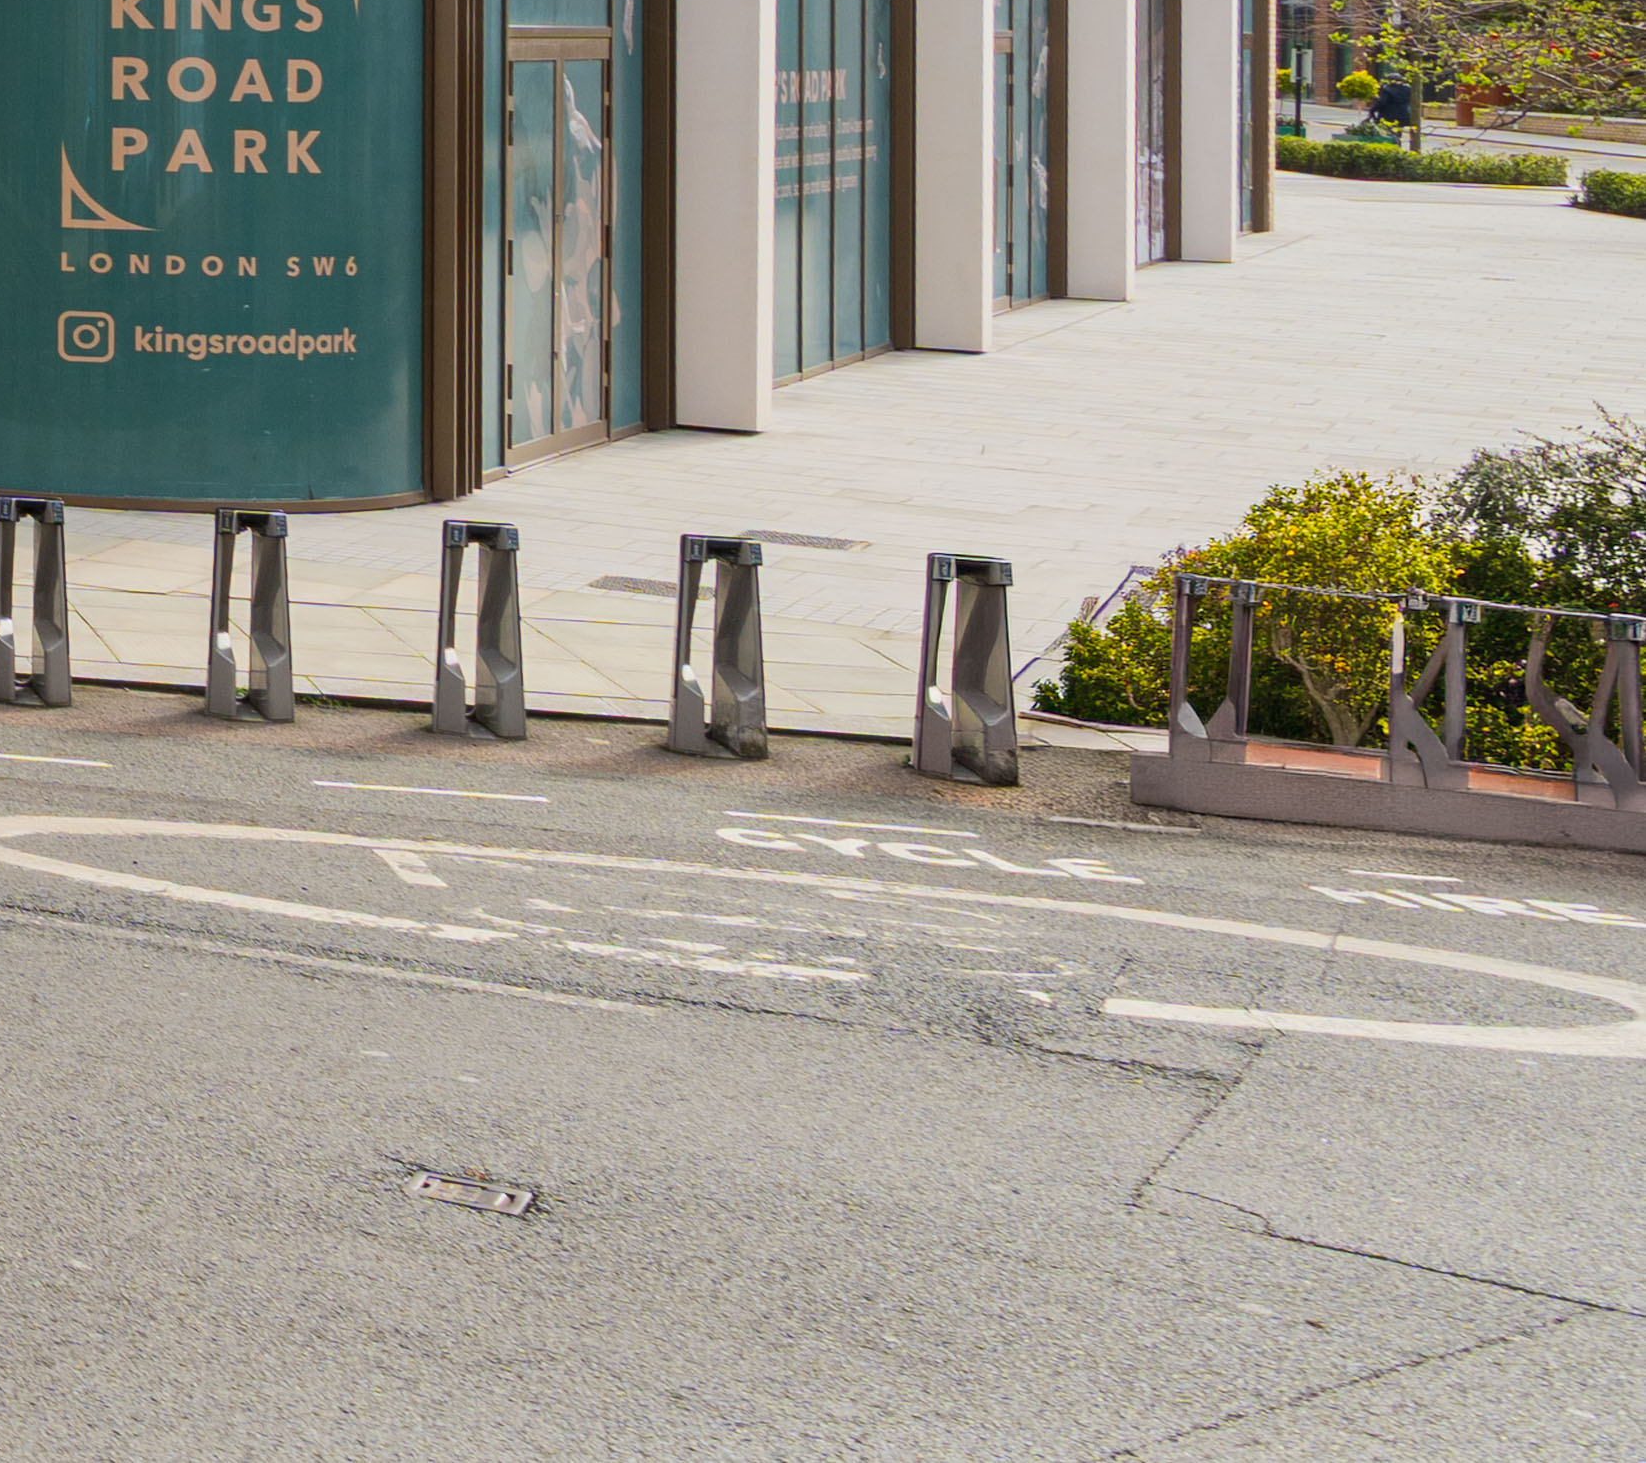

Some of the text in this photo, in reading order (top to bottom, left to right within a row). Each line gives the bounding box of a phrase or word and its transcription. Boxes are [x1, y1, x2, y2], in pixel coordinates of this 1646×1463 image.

[110, 55, 324, 104] ROAD
[110, 126, 322, 174] PARK
[60, 251, 359, 277] LONDON SW6
[134, 325, 358, 361] kingsroadpark
[715, 826, 1646, 929] CYCLE HIRE
